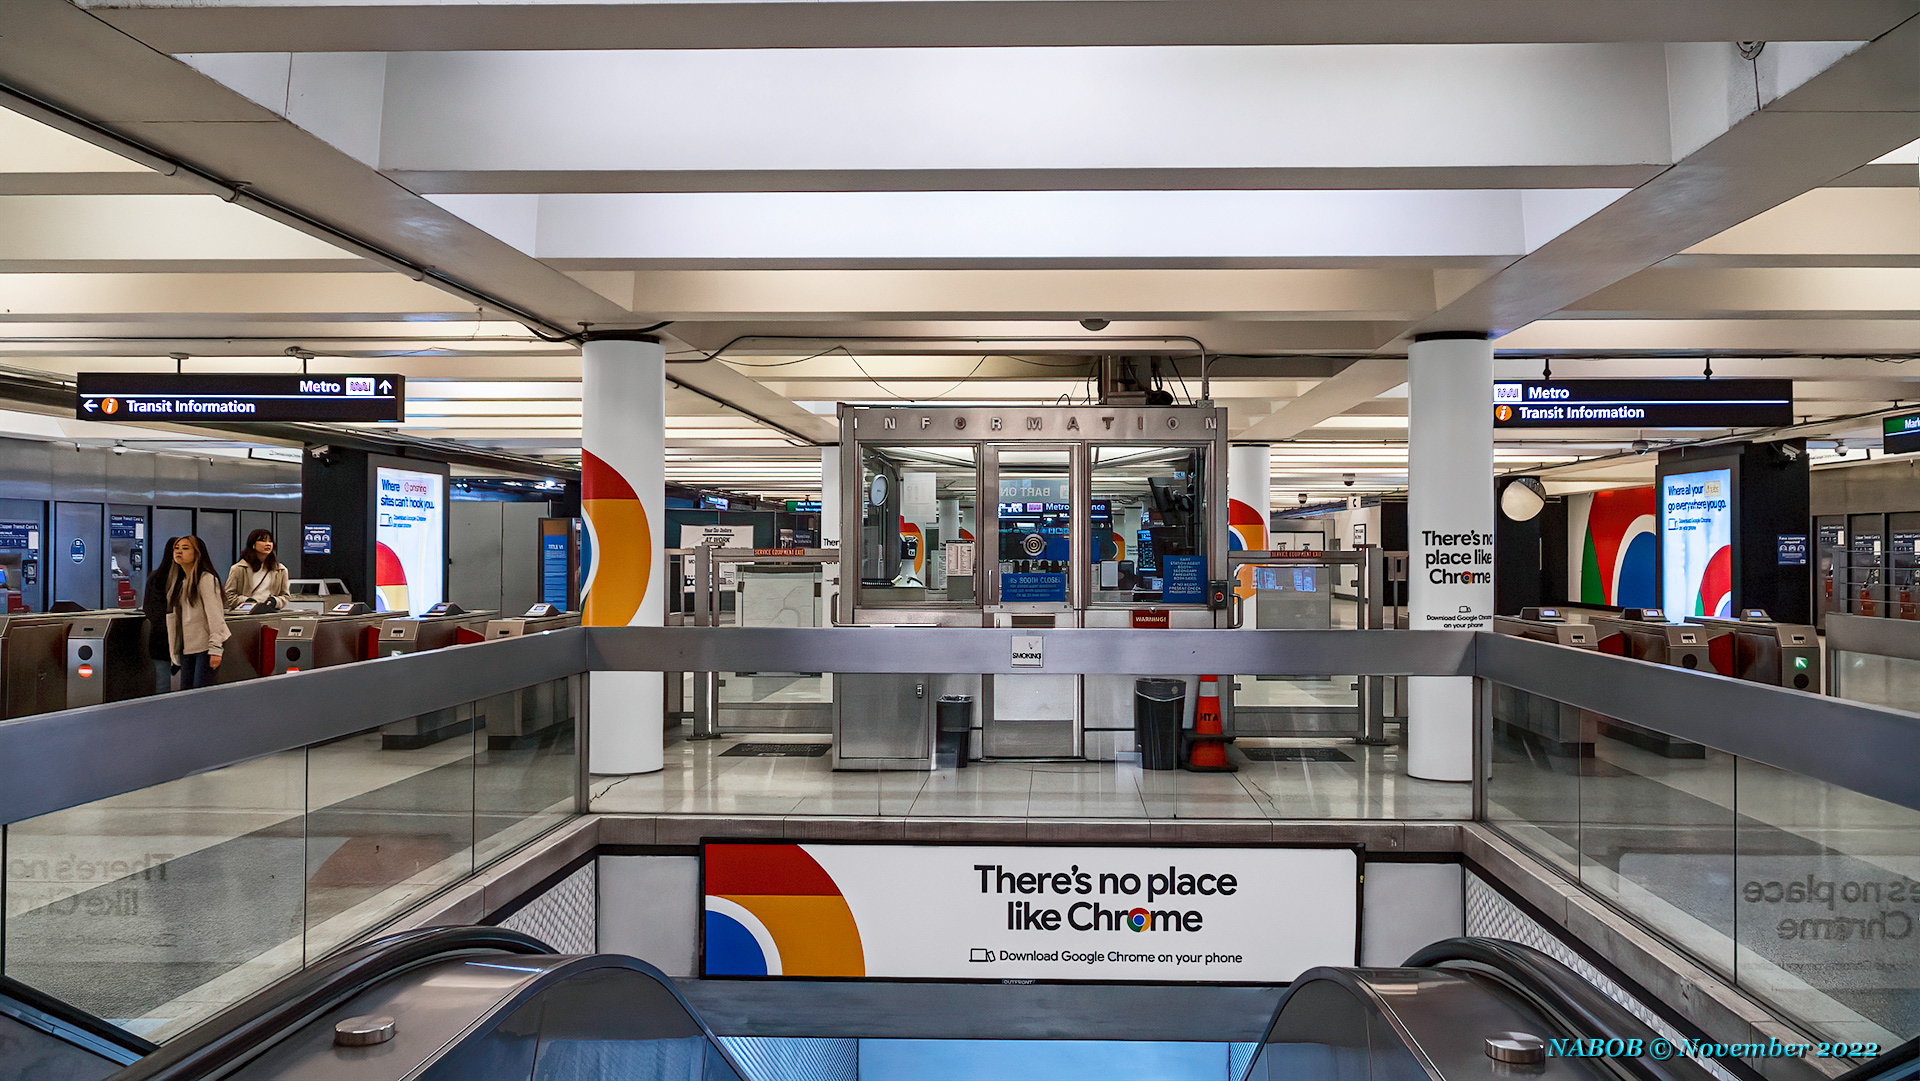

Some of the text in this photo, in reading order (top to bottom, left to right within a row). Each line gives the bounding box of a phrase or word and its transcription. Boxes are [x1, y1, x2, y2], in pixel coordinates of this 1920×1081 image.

[300, 380, 340, 393] Metro
[1528, 387, 1570, 399] Metro
[127, 400, 255, 413] Transit Information
[1519, 406, 1644, 419] Transit Information
[853, 416, 1217, 430] INFORMATION
[1904, 416, 1920, 429] Mark
[381, 478, 400, 492] Where
[1668, 485, 1685, 496] Where
[1692, 486, 1704, 498] your
[380, 494, 394, 506] sites
[409, 498, 424, 508] hook
[1668, 502, 1676, 514] go
[1676, 499, 1706, 512] everywhere
[1706, 500, 1718, 512] you
[1422, 530, 1480, 546] There's
[1426, 549, 1492, 569] place like
[1430, 568, 1490, 584] Chrome
[974, 864, 1238, 903] There's no place
[1008, 901, 1203, 932] like Chrome
[1000, 951, 1243, 966] Download Google Chrome on your phone
